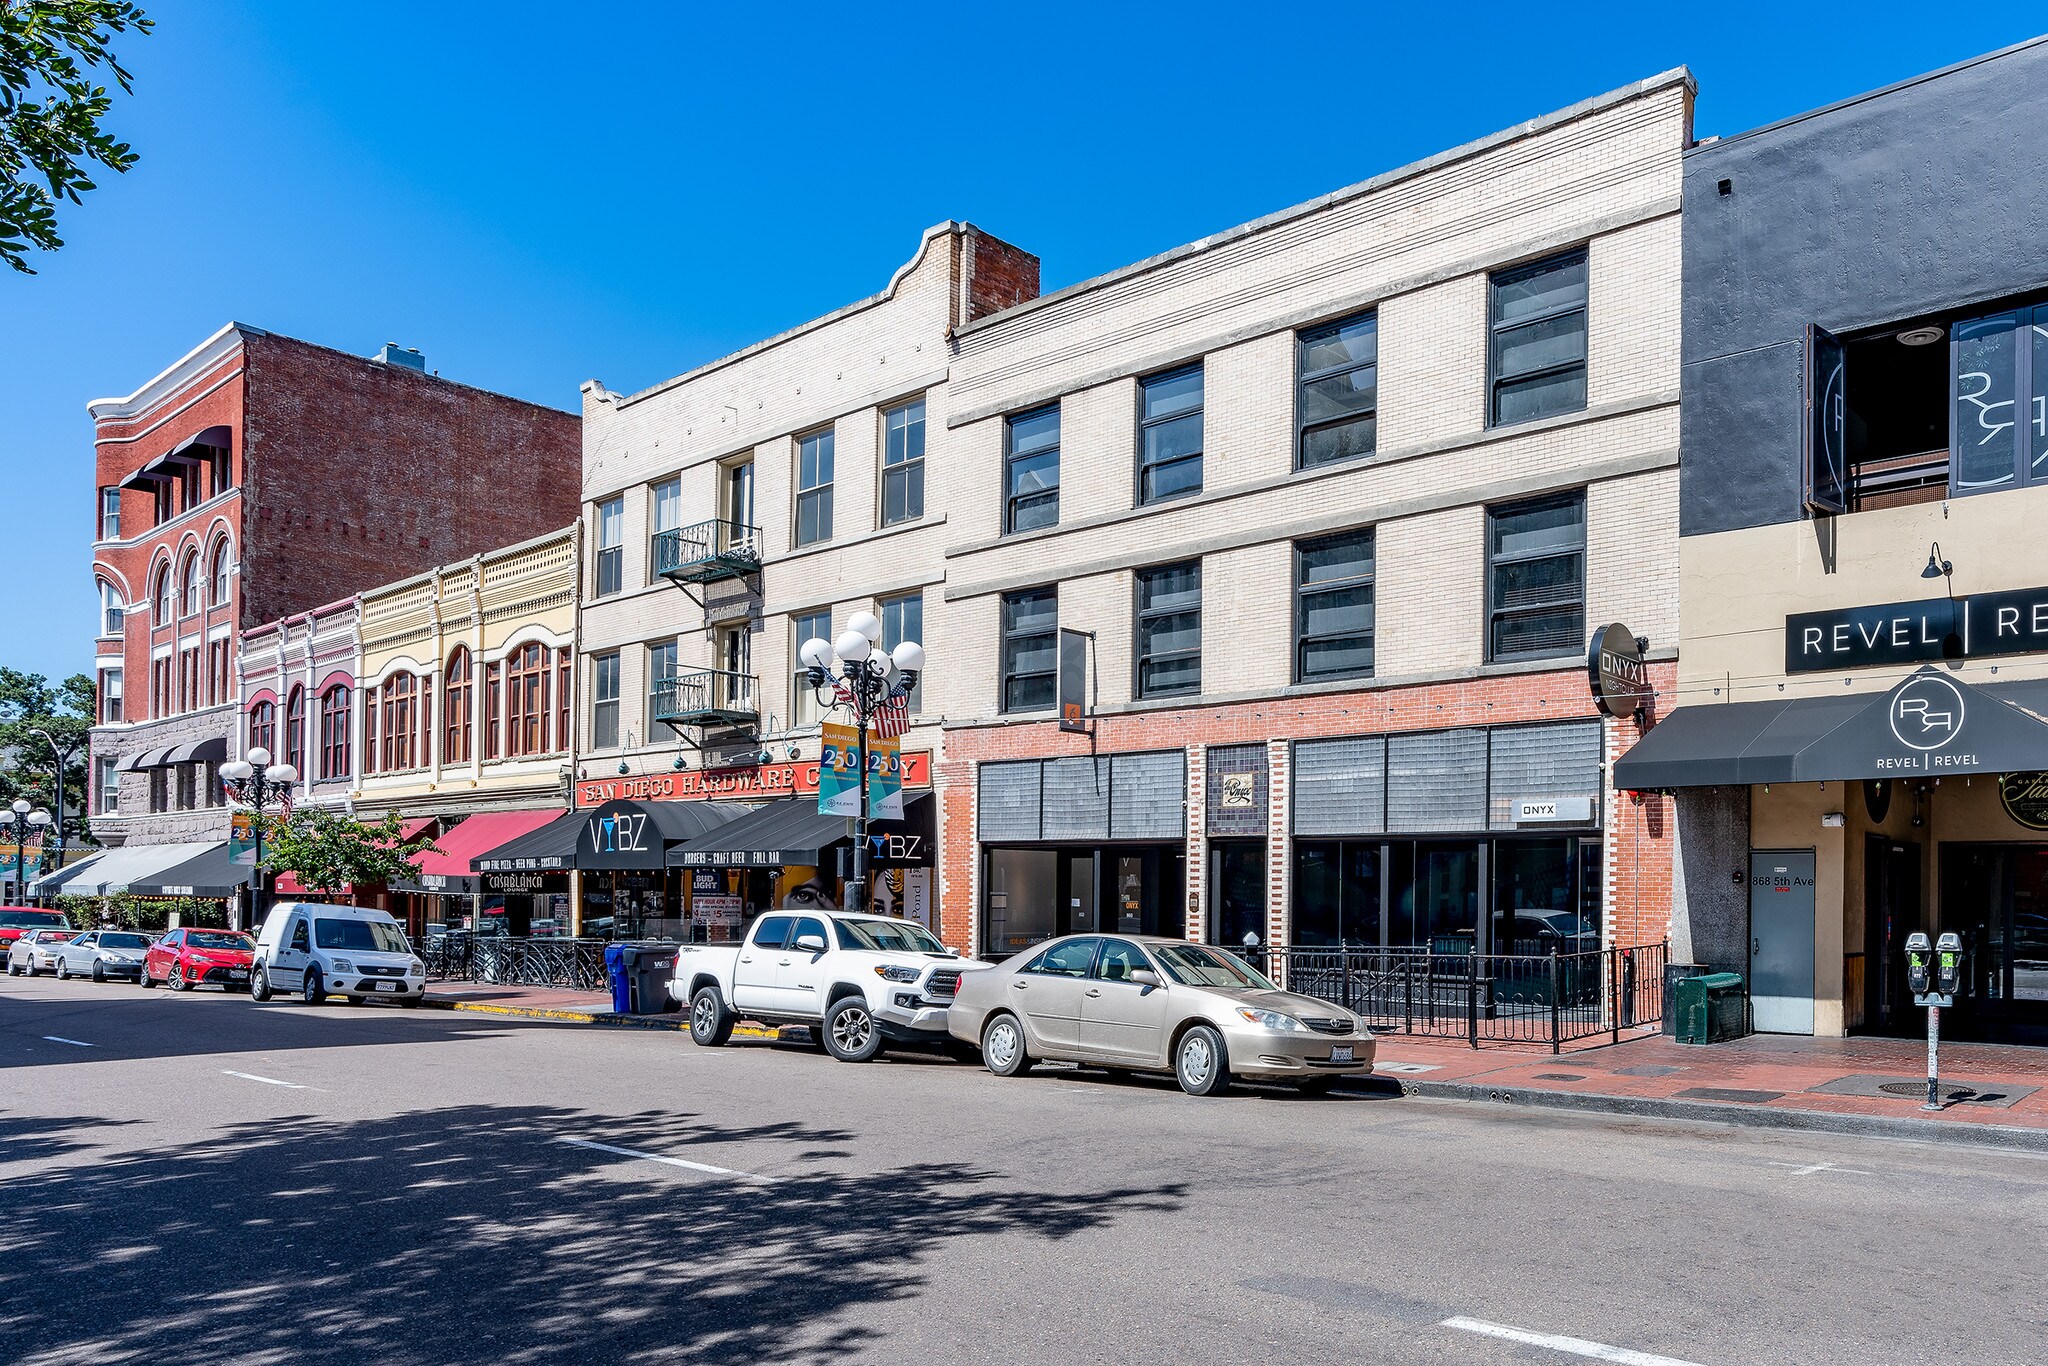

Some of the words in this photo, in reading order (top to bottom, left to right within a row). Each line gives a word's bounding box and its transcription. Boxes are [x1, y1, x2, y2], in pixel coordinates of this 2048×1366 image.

[1803, 615, 1939, 655] REVEL
[1602, 652, 1638, 682] ONYX
[824, 732, 837, 741] SAN
[837, 734, 857, 743] DIEGO
[824, 749, 858, 768] 250
[870, 755, 899, 772] 250
[1877, 757, 1919, 769] REVEL
[1935, 754, 1979, 767] REVEL
[585, 784, 617, 801] SAN
[622, 777, 674, 799] DIEGO
[682, 767, 796, 795] HARDWARE
[1523, 805, 1554, 815] ONYX
[234, 829, 255, 838] 250
[500, 859, 512, 870] PIZZA
[540, 857, 562, 868] COCKTAILS
[713, 852, 730, 864] CRAFT
[731, 851, 745, 864] BEER
[753, 851, 767, 864] FULL
[768, 851, 780, 864] BAR
[489, 876, 543, 888] CASABLANCA
[1752, 876, 1771, 886] 868
[1773, 876, 1791, 886] 5th
[1793, 876, 1814, 886] Ave
[747, 903, 753, 911] A
[1125, 901, 1139, 909] ONYX
